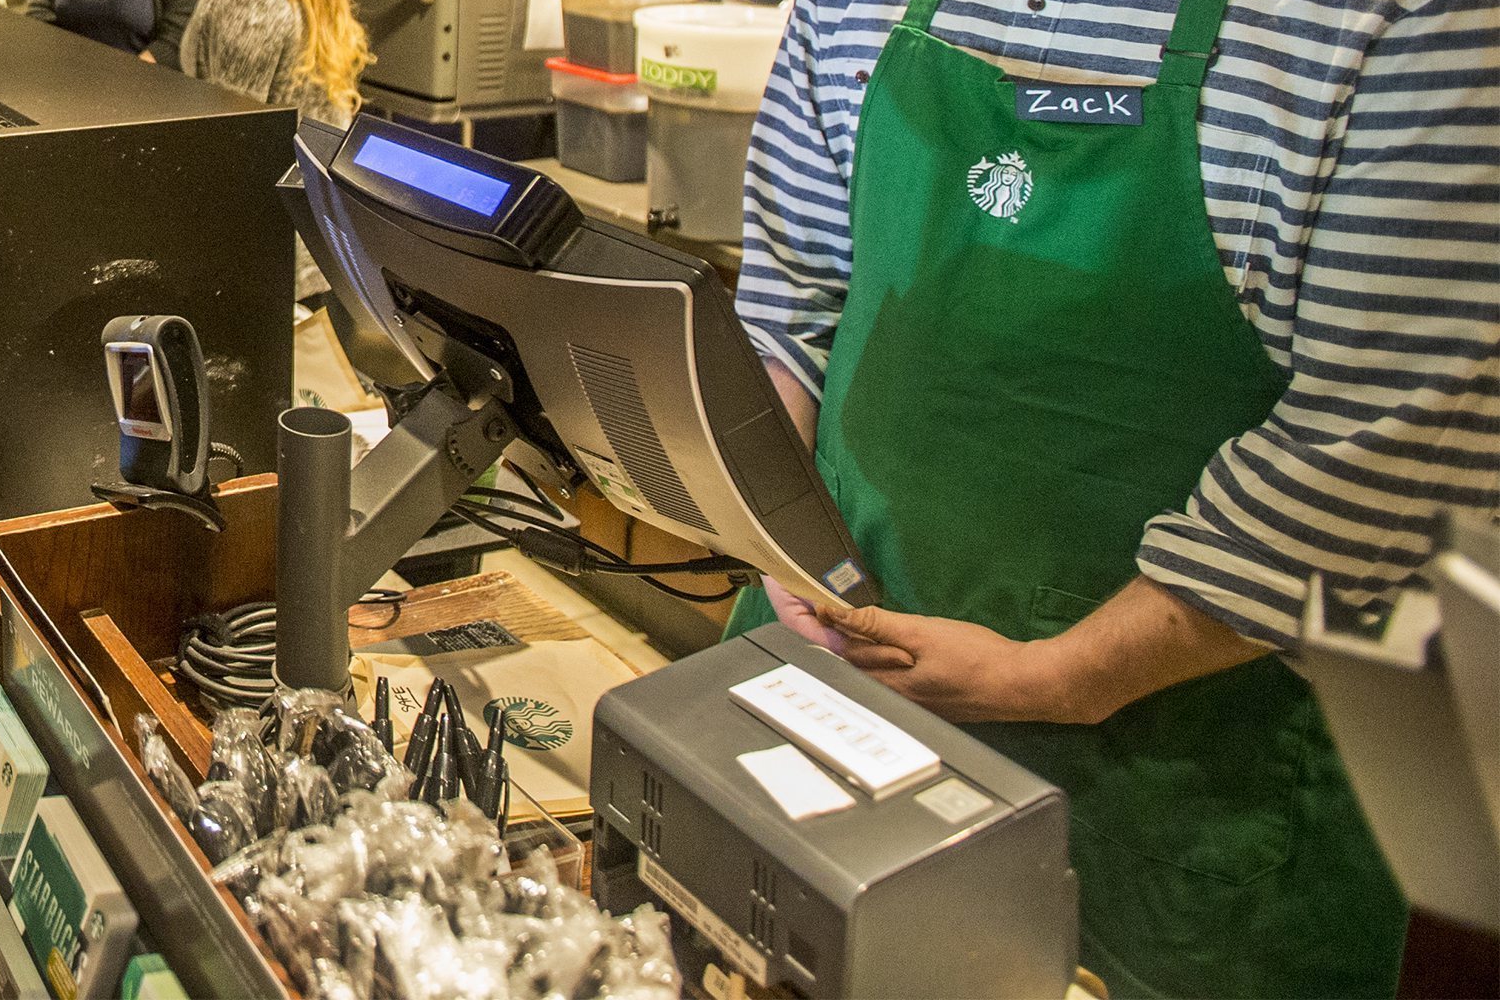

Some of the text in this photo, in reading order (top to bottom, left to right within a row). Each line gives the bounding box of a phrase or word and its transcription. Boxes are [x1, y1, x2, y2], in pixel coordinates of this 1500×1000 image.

[643, 60, 714, 88] TODDY
[1026, 89, 1131, 116] Zack
[31, 669, 90, 769] REWARDS
